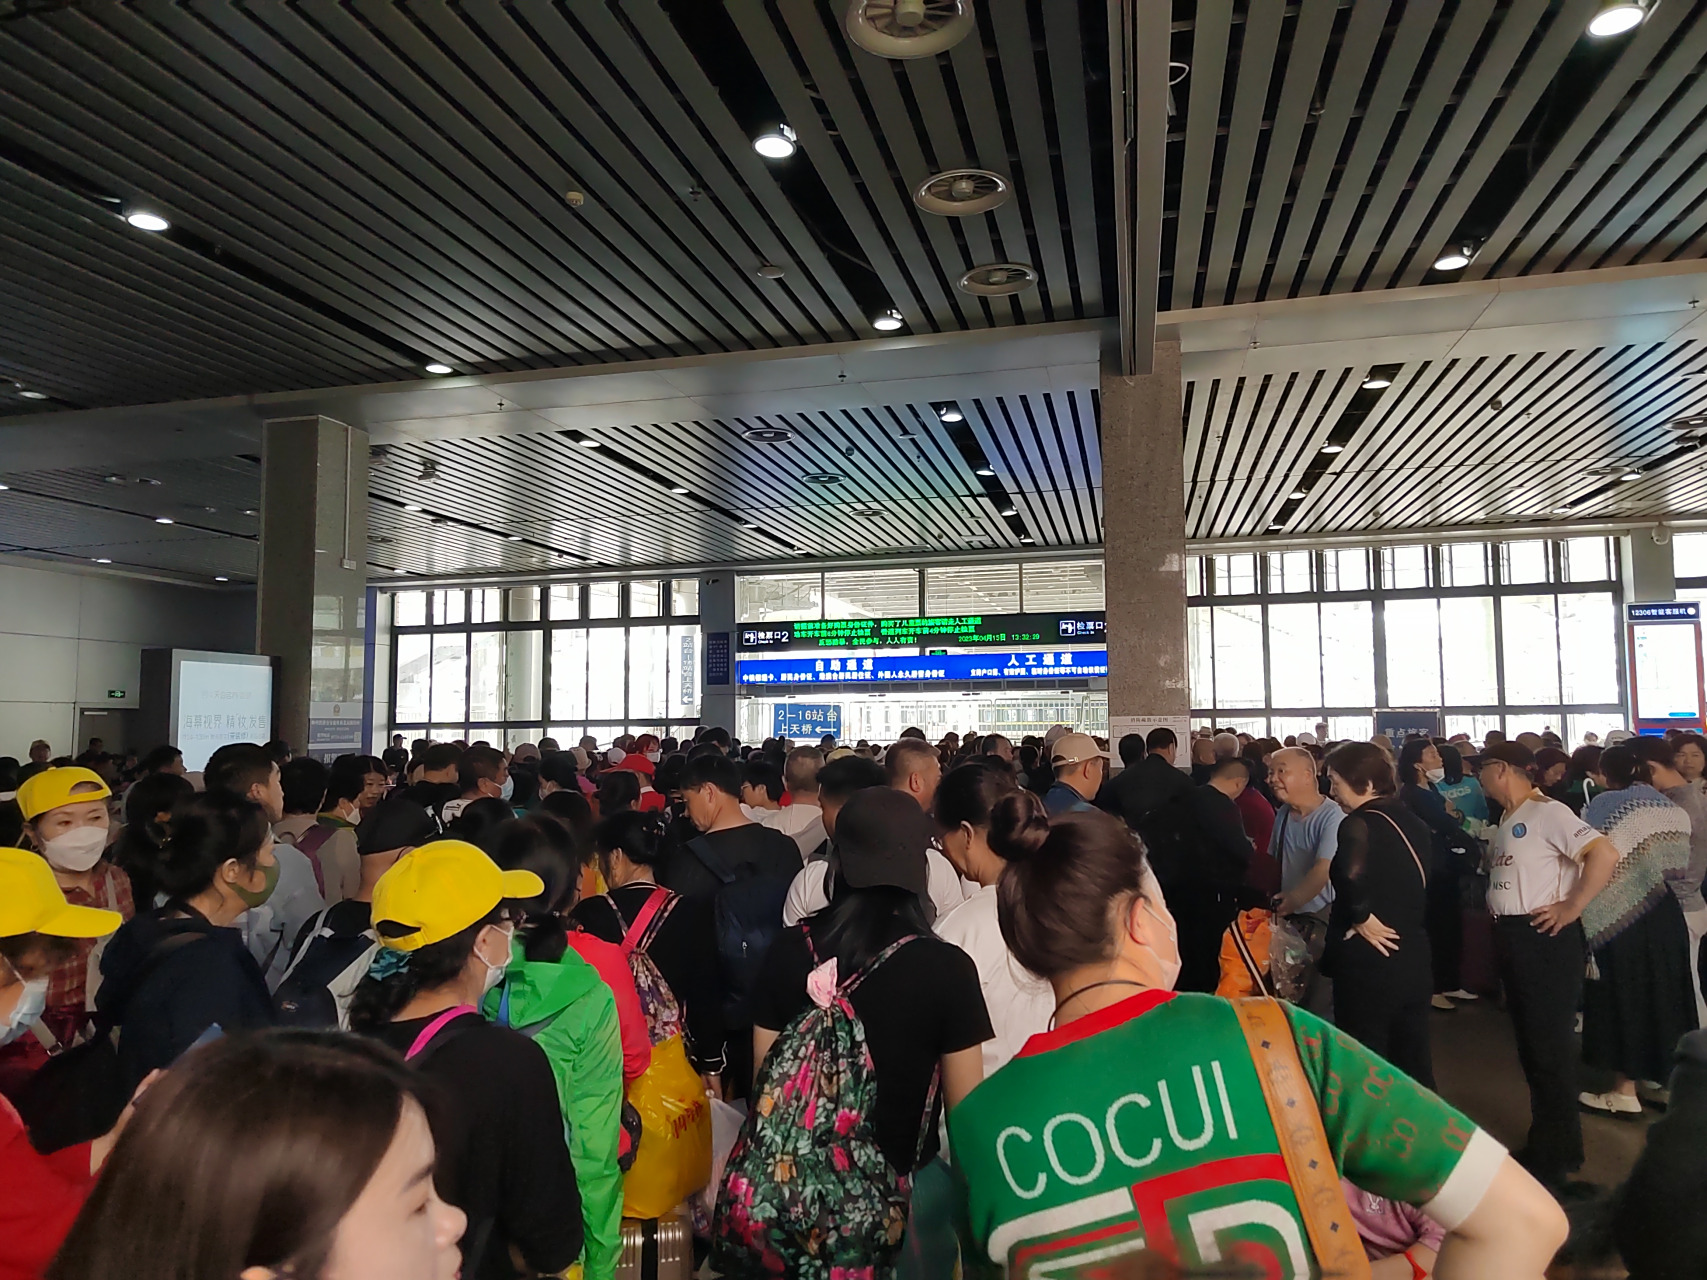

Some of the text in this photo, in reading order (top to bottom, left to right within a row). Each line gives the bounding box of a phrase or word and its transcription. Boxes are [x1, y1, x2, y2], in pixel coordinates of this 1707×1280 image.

[1077, 621, 1107, 632] 检票口
[815, 659, 874, 671] 自助通道
[1007, 653, 1073, 666] 人工通道
[778, 723, 813, 735] 上天桥
[996, 1060, 1239, 1200] COCUI
